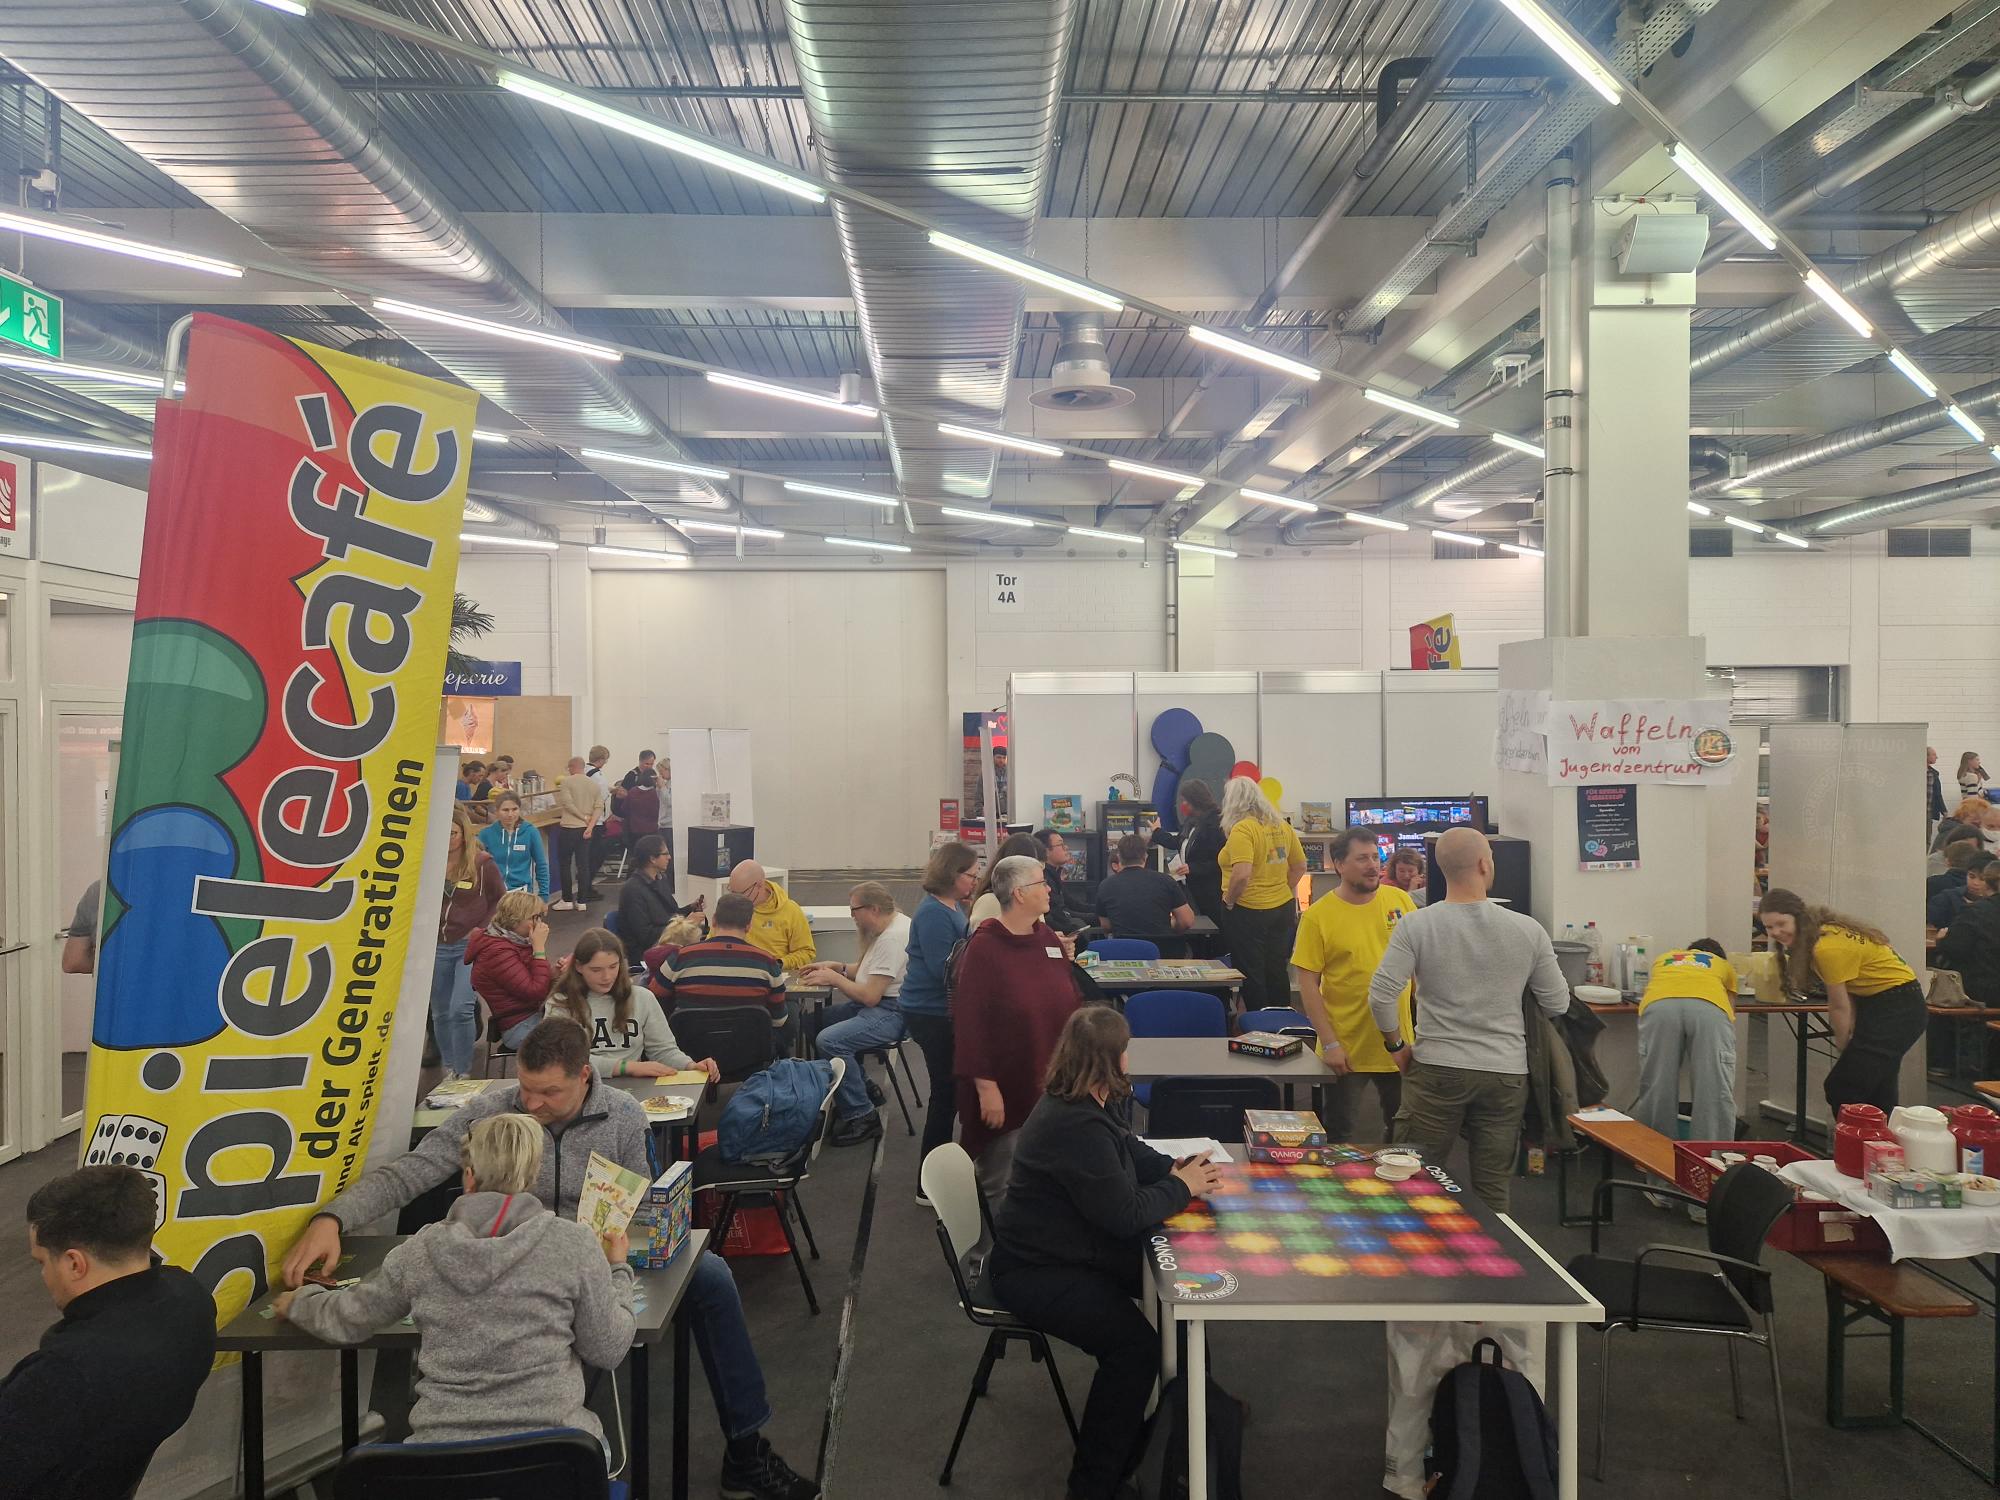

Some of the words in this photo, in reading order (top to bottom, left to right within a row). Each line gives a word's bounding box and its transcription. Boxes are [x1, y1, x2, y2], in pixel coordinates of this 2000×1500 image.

[996, 574, 1018, 586] Tor
[998, 591, 1016, 603] 4A
[1569, 712, 1693, 746] Waffeln
[1612, 745, 1641, 755] vom
[1560, 758, 1703, 780] Jugendzentrum
[322, 759, 425, 1067] Generationen
[590, 1017, 639, 1049] AP
[299, 1079, 351, 1159] der
[334, 1153, 356, 1194] und
[348, 1116, 367, 1147] Alt
[360, 1048, 382, 1110] spielt
[1270, 1150, 1304, 1159] QANGO
[1150, 1235, 1178, 1271] QANGO
